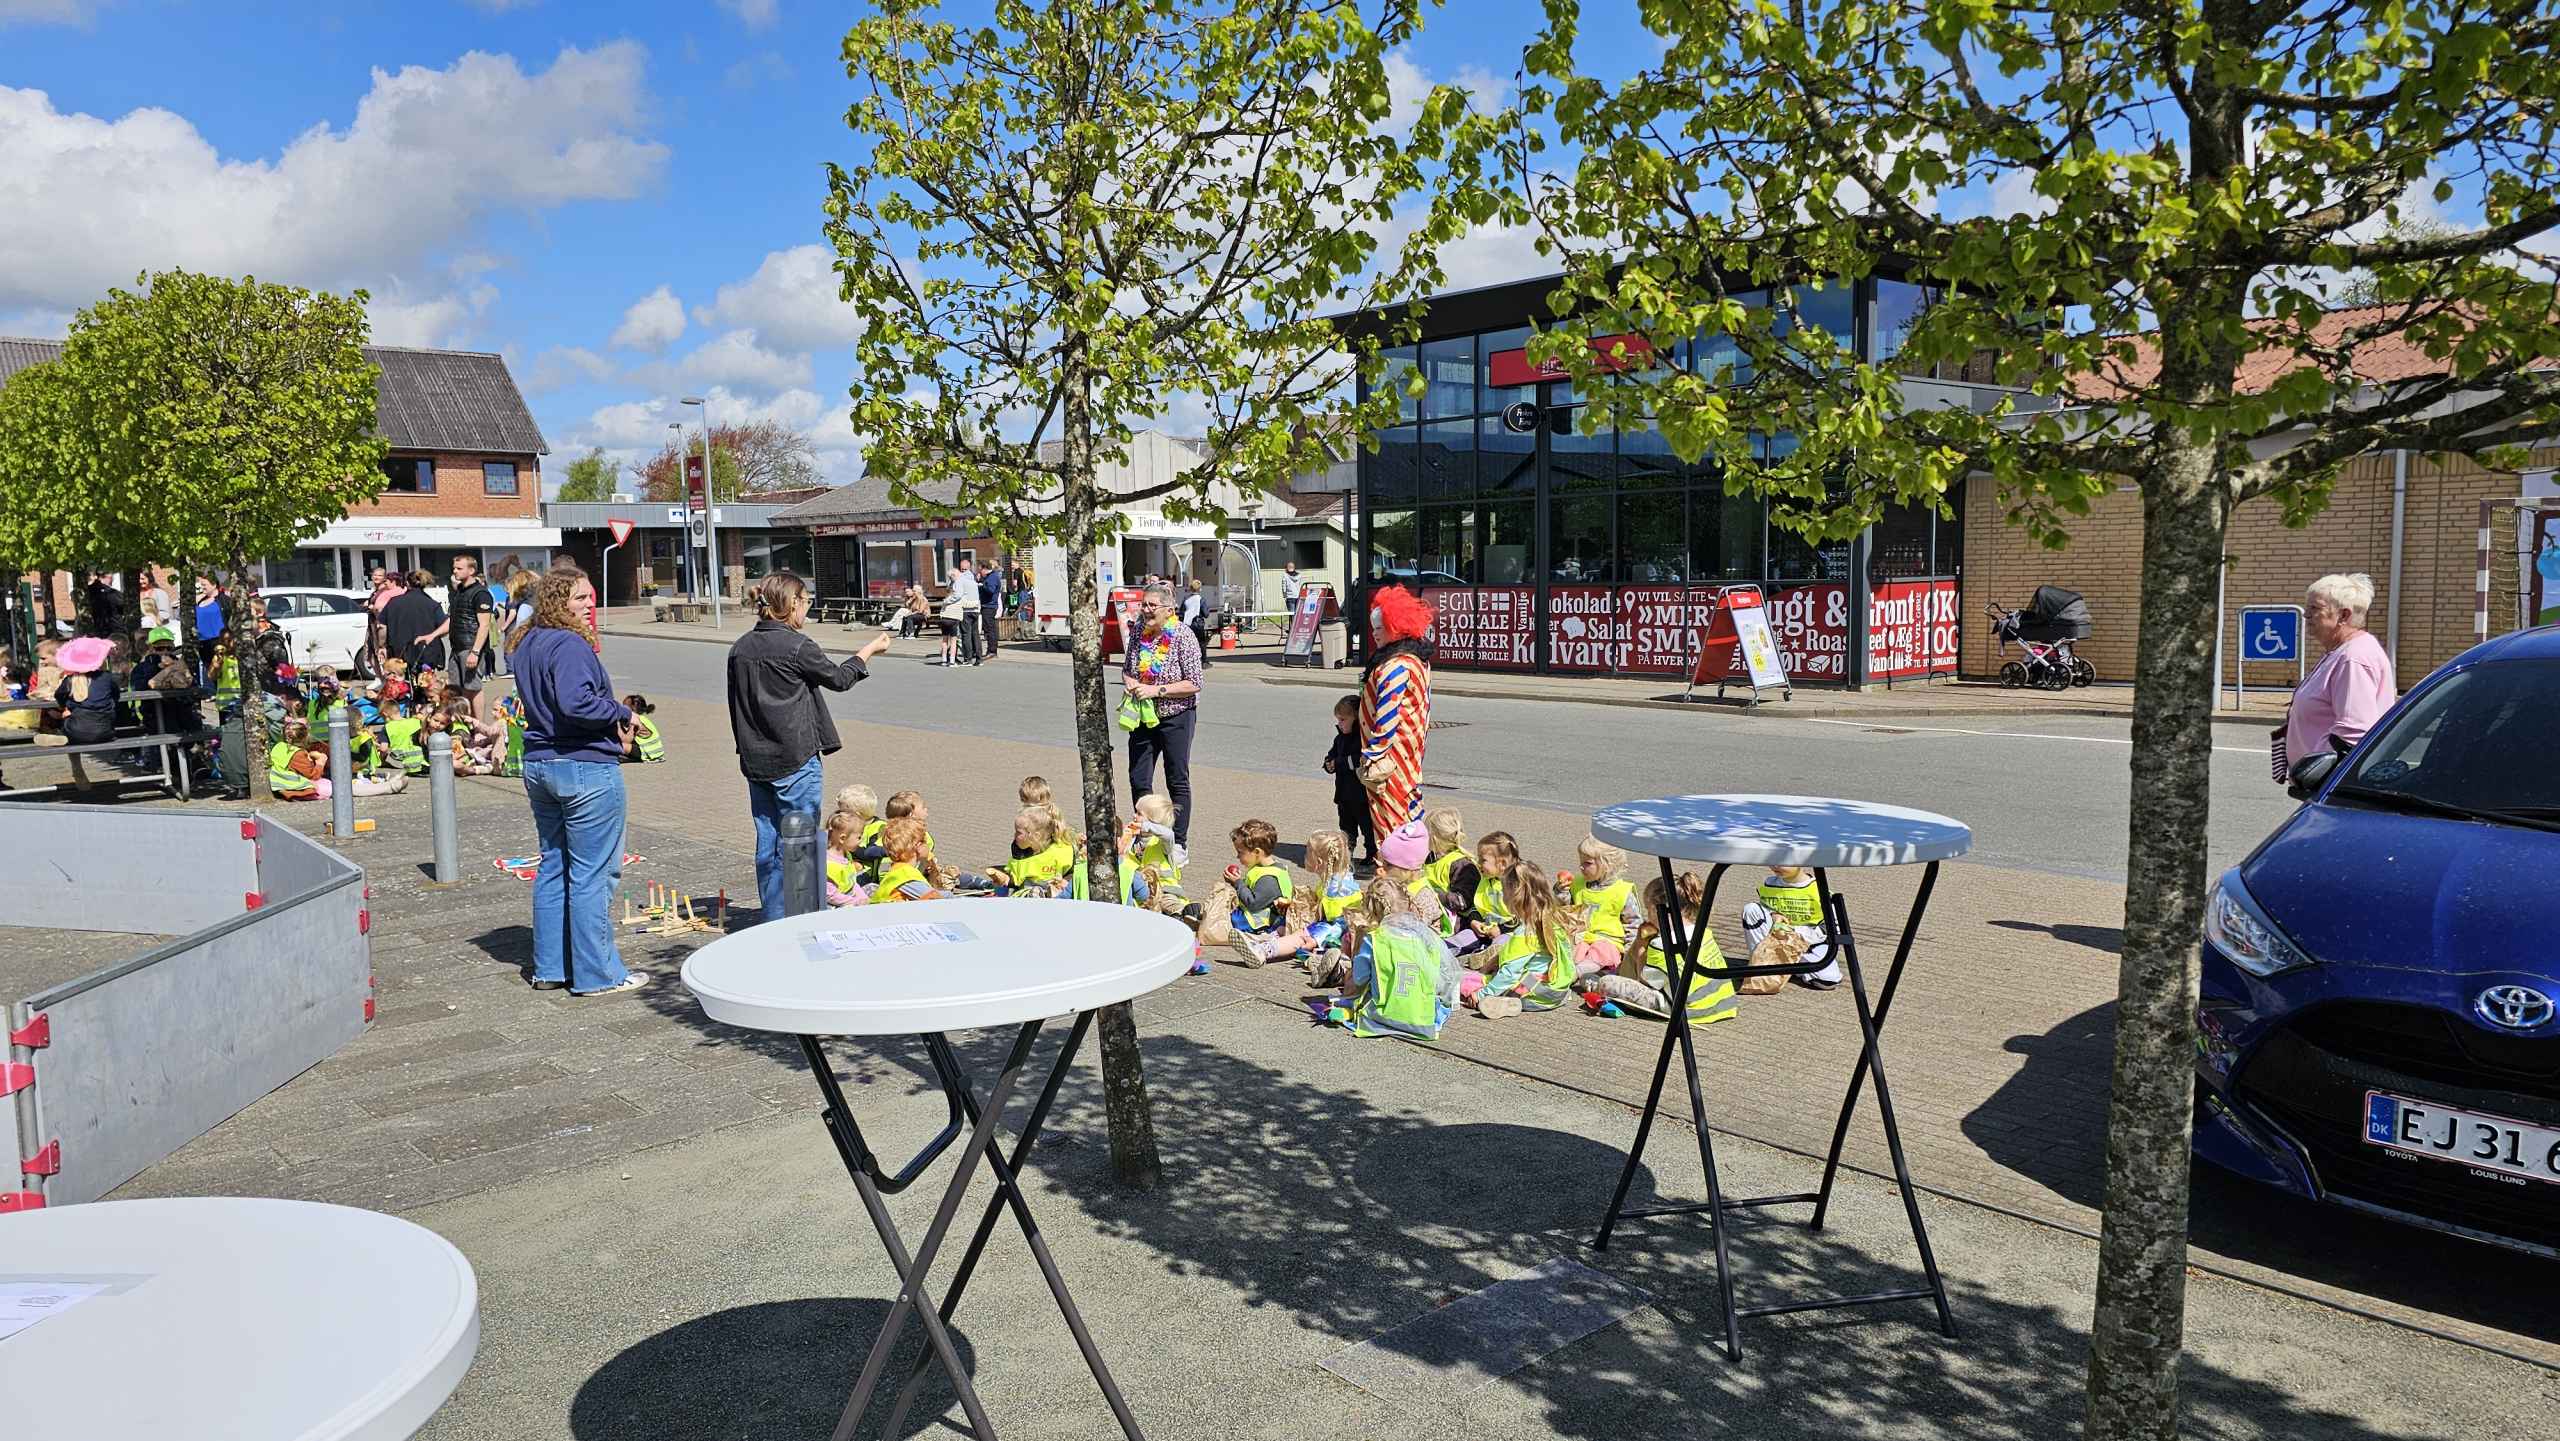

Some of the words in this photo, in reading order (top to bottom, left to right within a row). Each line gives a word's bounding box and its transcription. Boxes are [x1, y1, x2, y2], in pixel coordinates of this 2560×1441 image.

[1138, 516, 1166, 530] Tistrup
[1449, 592, 1489, 611] GIVE
[1637, 591, 1649, 602] VI
[1652, 591, 1671, 602] VIL
[1517, 591, 1529, 631] Vanilje
[1766, 591, 1817, 637] ugt
[1825, 590, 1847, 627] &
[1440, 616, 1447, 630] VI
[1588, 616, 1632, 640] Salat
[1637, 628, 1702, 653] SMA
[1440, 650, 1450, 659] EN
[1637, 651, 1650, 665] PÅ
[1653, 655, 1698, 667] HVERDA
[1869, 651, 1894, 673] Vand
[1394, 961, 1421, 996] F
[2371, 1122, 2389, 1136] DK
[2400, 1108, 2458, 1150] EJ
[2473, 1123, 2526, 1167] 31
[2384, 1148, 2419, 1163] TOYOTA
[2470, 1168, 2498, 1181] LOUIS
[2499, 1174, 2528, 1187] LUND
